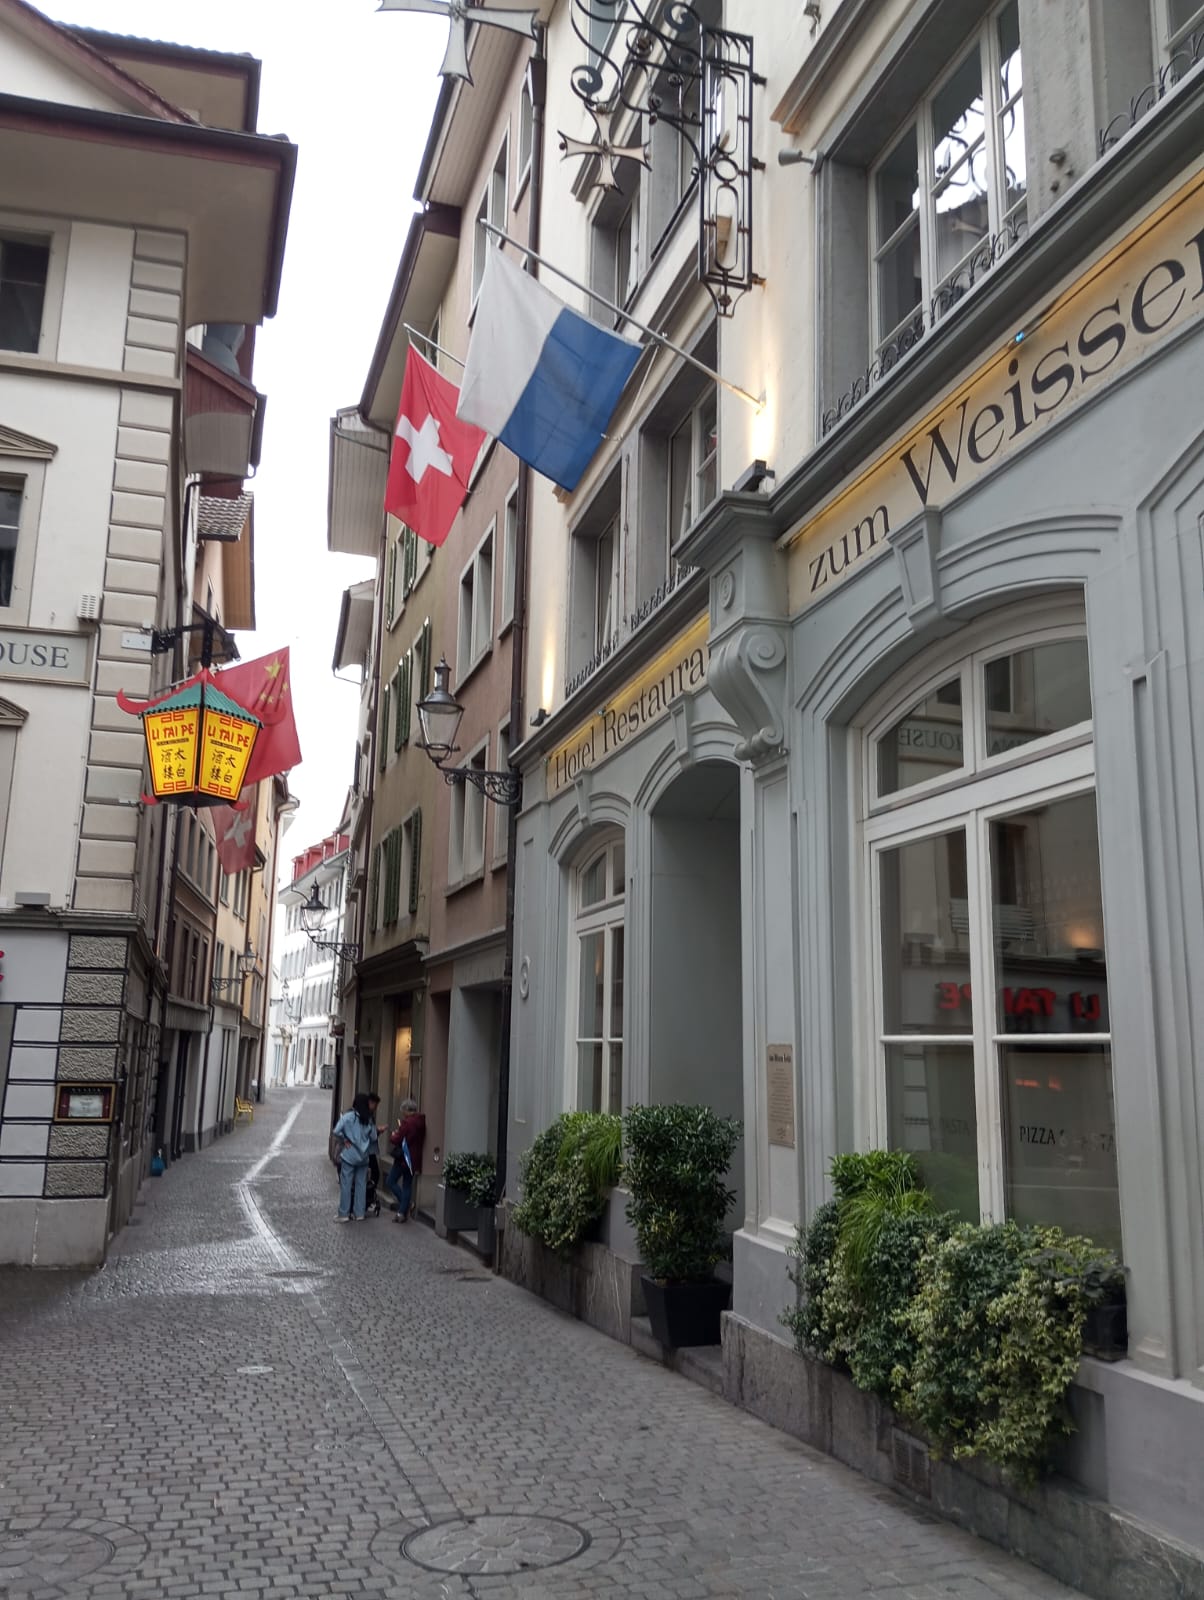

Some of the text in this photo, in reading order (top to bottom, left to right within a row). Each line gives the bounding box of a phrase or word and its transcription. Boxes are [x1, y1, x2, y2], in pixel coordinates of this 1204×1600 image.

[808, 504, 891, 593] zum
[554, 648, 711, 789] Hotel Restaura
[151, 723, 195, 740] LI TAI PE
[207, 725, 217, 737] LI
[219, 728, 235, 743] TAI
[236, 733, 250, 748] PE
[1019, 1126, 1056, 1145] PIZZA
